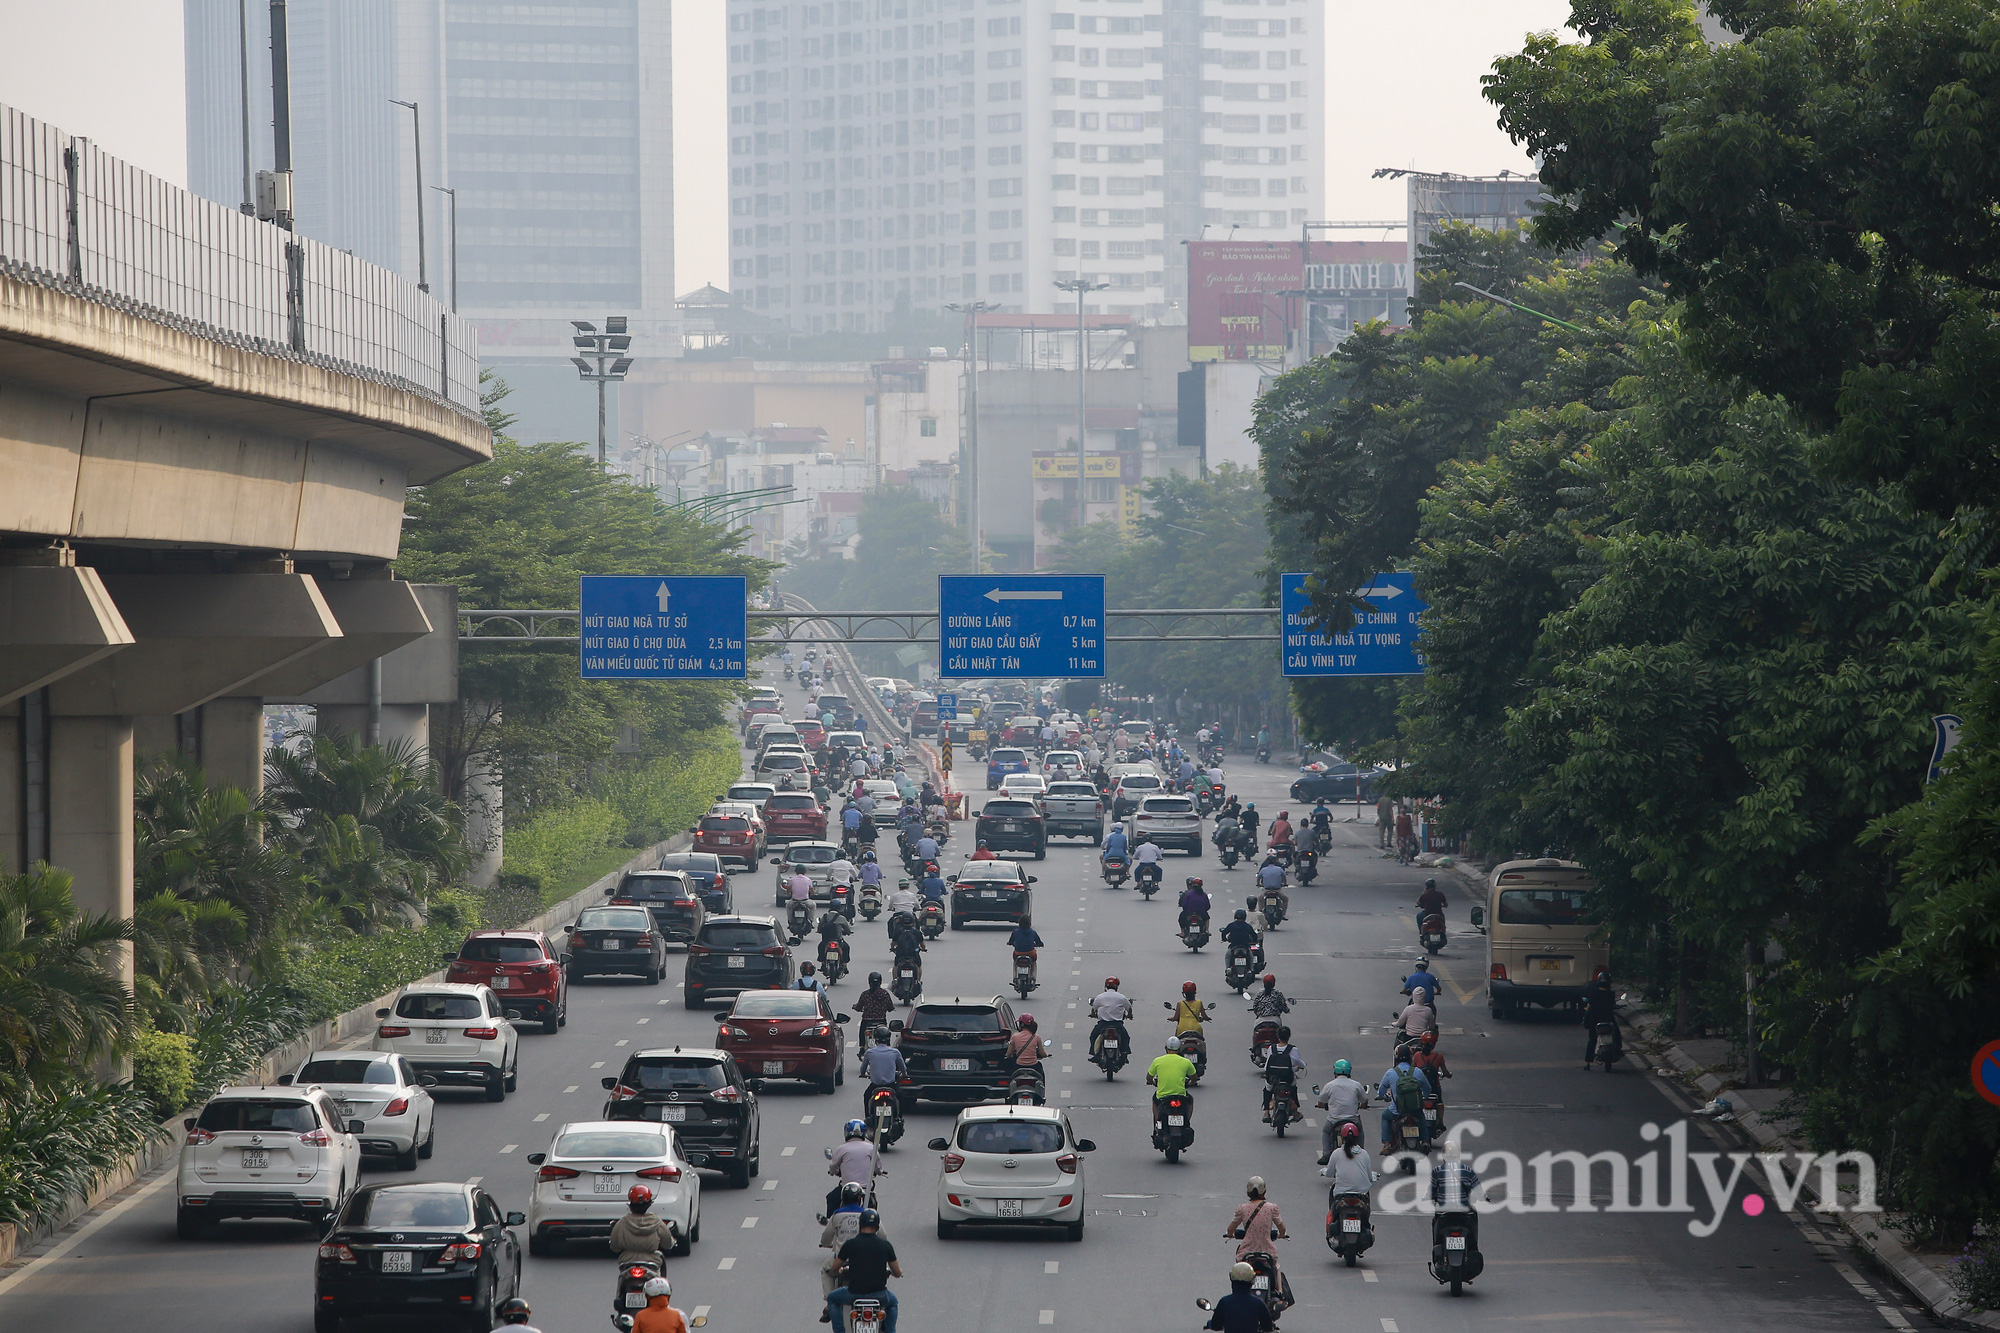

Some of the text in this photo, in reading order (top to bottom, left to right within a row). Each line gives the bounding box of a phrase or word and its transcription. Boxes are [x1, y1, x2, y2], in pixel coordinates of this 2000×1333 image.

[585, 613, 688, 628] NÚT GIAO NGÃ TƯ SỞ
[948, 613, 981, 628] ĐƯỜNG
[986, 612, 1011, 628] LÁNG
[1081, 616, 1096, 627] km
[1368, 613, 1396, 624] CHINH
[585, 634, 604, 649] NÚT
[607, 638, 629, 649] GIAO
[633, 635, 639, 649] Ô
[644, 637, 663, 651] CHỢ
[667, 634, 686, 649] DỪA
[727, 638, 741, 649] km
[949, 633, 1096, 648] NÚT GIAO CẦU GIẤY 5 km
[1288, 631, 1307, 646] NÚT
[1335, 631, 1354, 646] NGÃ
[1359, 633, 1372, 646] TƯ
[1375, 633, 1400, 647] VỌNG
[586, 656, 604, 670] VĂN
[607, 653, 631, 670] MIẾU
[634, 654, 659, 670] QUỐC
[662, 654, 675, 670] TỬ
[679, 655, 702, 670] GIÁM
[727, 659, 741, 670] km
[949, 655, 1096, 671] CẦU NHẬT TÂN 11 km
[1288, 652, 1307, 667] CẦU
[1312, 652, 1334, 667] VĨNH
[1339, 655, 1357, 666] TUY
[999, 1208, 1021, 1217] 165.83
[390, 1252, 405, 1262] 29A
[383, 1262, 411, 1272] 653.98
